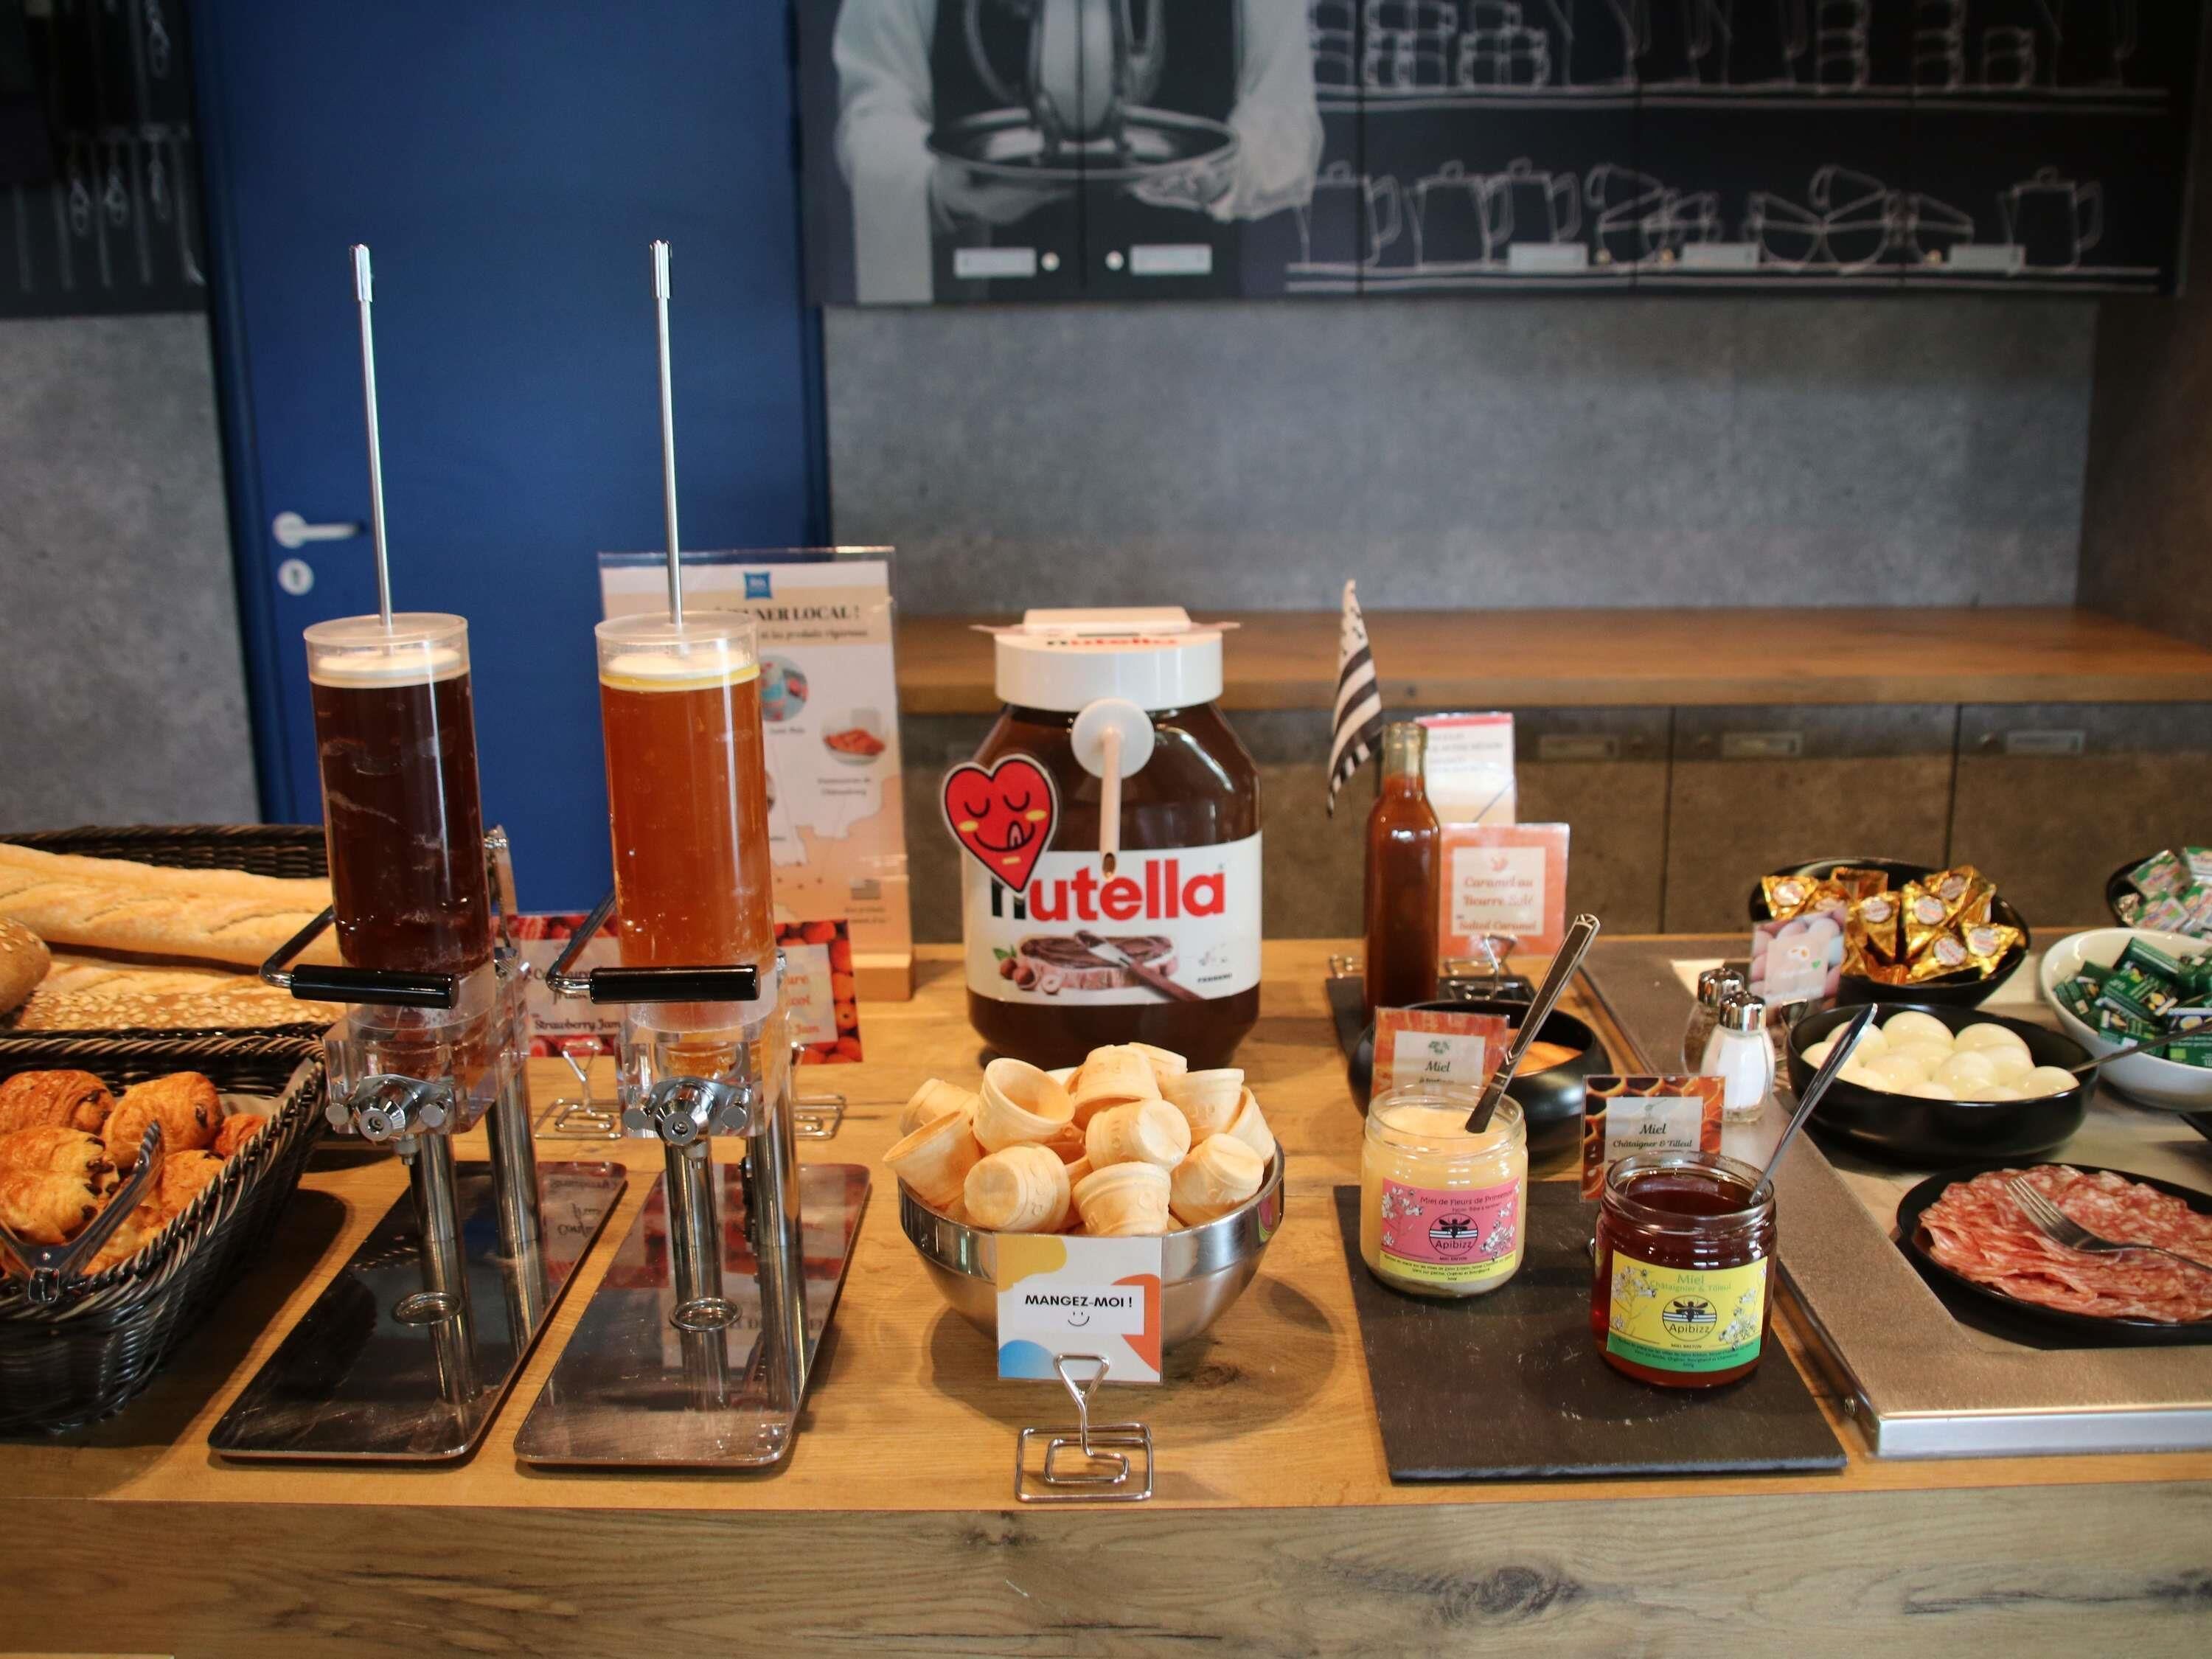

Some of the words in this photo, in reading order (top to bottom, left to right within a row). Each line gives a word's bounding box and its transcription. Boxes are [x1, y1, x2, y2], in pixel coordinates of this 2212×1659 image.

[793, 605, 849, 620] LOCAL
[1463, 875, 1516, 888] Caramel
[990, 859, 1225, 922] nutella
[535, 1018, 595, 1030] Strawberry
[597, 1018, 622, 1030] Jam
[1425, 1061, 1450, 1072] Miel
[1639, 1123, 1666, 1135] Miel
[1420, 1197, 1436, 1205] Miel
[1439, 1197, 1448, 1206] de
[1436, 1240, 1472, 1250] Apibizz
[1677, 1274, 1704, 1284] Miel
[1025, 1295, 1124, 1307] MANGEZ-MOI
[1128, 1296, 1133, 1307] !
[1669, 1324, 1711, 1334] Apibizz
